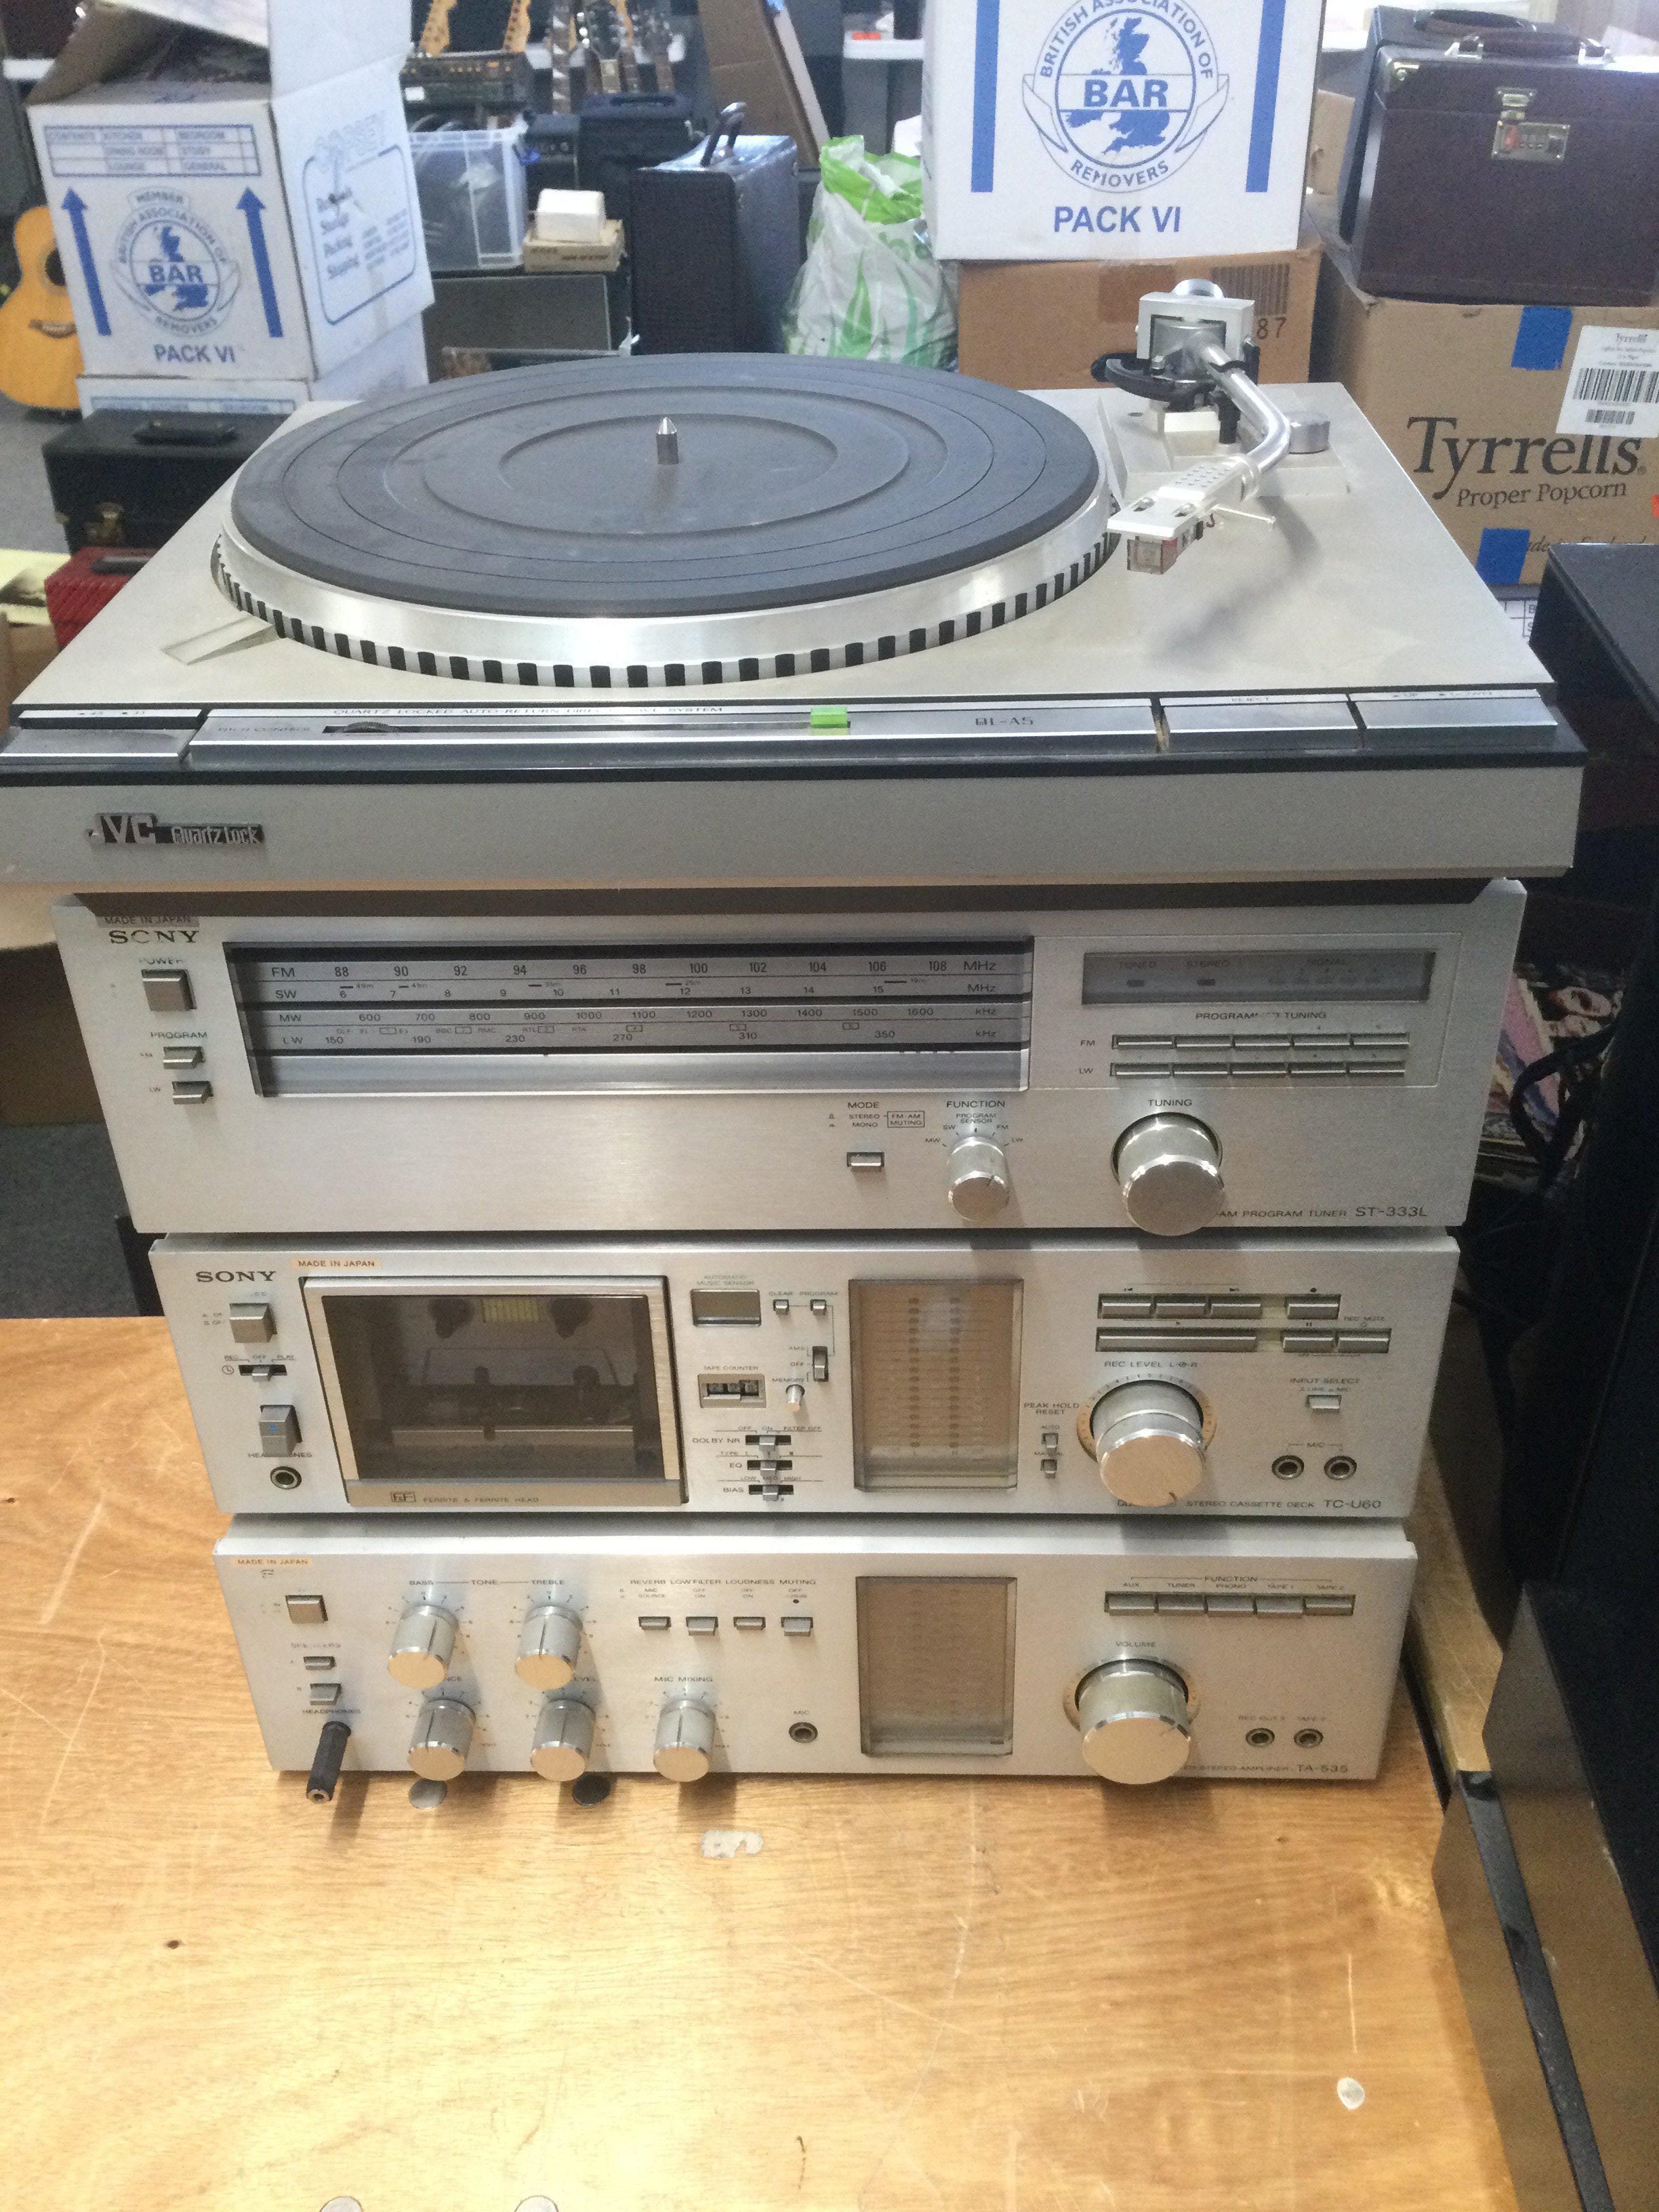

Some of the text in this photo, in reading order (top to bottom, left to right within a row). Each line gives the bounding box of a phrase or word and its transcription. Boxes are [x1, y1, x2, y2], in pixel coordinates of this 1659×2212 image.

[1040, 0, 1213, 79] BRITISH AIATION OF
[1084, 79, 1168, 107] BAR
[1071, 160, 1169, 186] REMOVERS
[1054, 206, 1181, 232] PACK VI
[148, 265, 203, 283] BAR
[155, 315, 217, 333] REMOVERS
[154, 344, 236, 363] PACK VI
[1407, 416, 1643, 500] Tyrrells
[1456, 482, 1627, 508] Proper Popcorn
[104, 916, 136, 924] MADE
[108, 930, 200, 944] SONY
[272, 960, 997, 978] FM 88 90 92 94 96 98 100 102 104 106 108 MHz
[275, 990, 297, 999] SW
[340, 990, 347, 998] 6
[390, 990, 396, 998] 7
[500, 989, 507, 997] 9
[553, 988, 564, 996] 10
[740, 987, 752, 995] 13
[873, 985, 884, 994] 15
[967, 983, 996, 992] MHz
[469, 1012, 491, 1021] 800
[632, 1010, 656, 1019] 1100
[798, 1008, 823, 1017] 1400
[975, 1007, 996, 1015] kHz
[150, 1031, 208, 1040] PROGRAM
[283, 1036, 303, 1044] LW
[326, 1036, 344, 1044] 150
[505, 1035, 525, 1043] 230
[613, 1033, 633, 1042] 270
[738, 1032, 758, 1040] 310
[847, 1101, 879, 1109] MODE
[946, 1101, 1006, 1109] FUNCTION
[1148, 1099, 1193, 1107] TUNING
[1355, 1206, 1427, 1218] ST-333L
[195, 1271, 276, 1283] SONY
[1187, 1500, 1227, 1508] STEREO
[1324, 1499, 1381, 1509] TC-U60
[1297, 1764, 1349, 1773] TA-535
